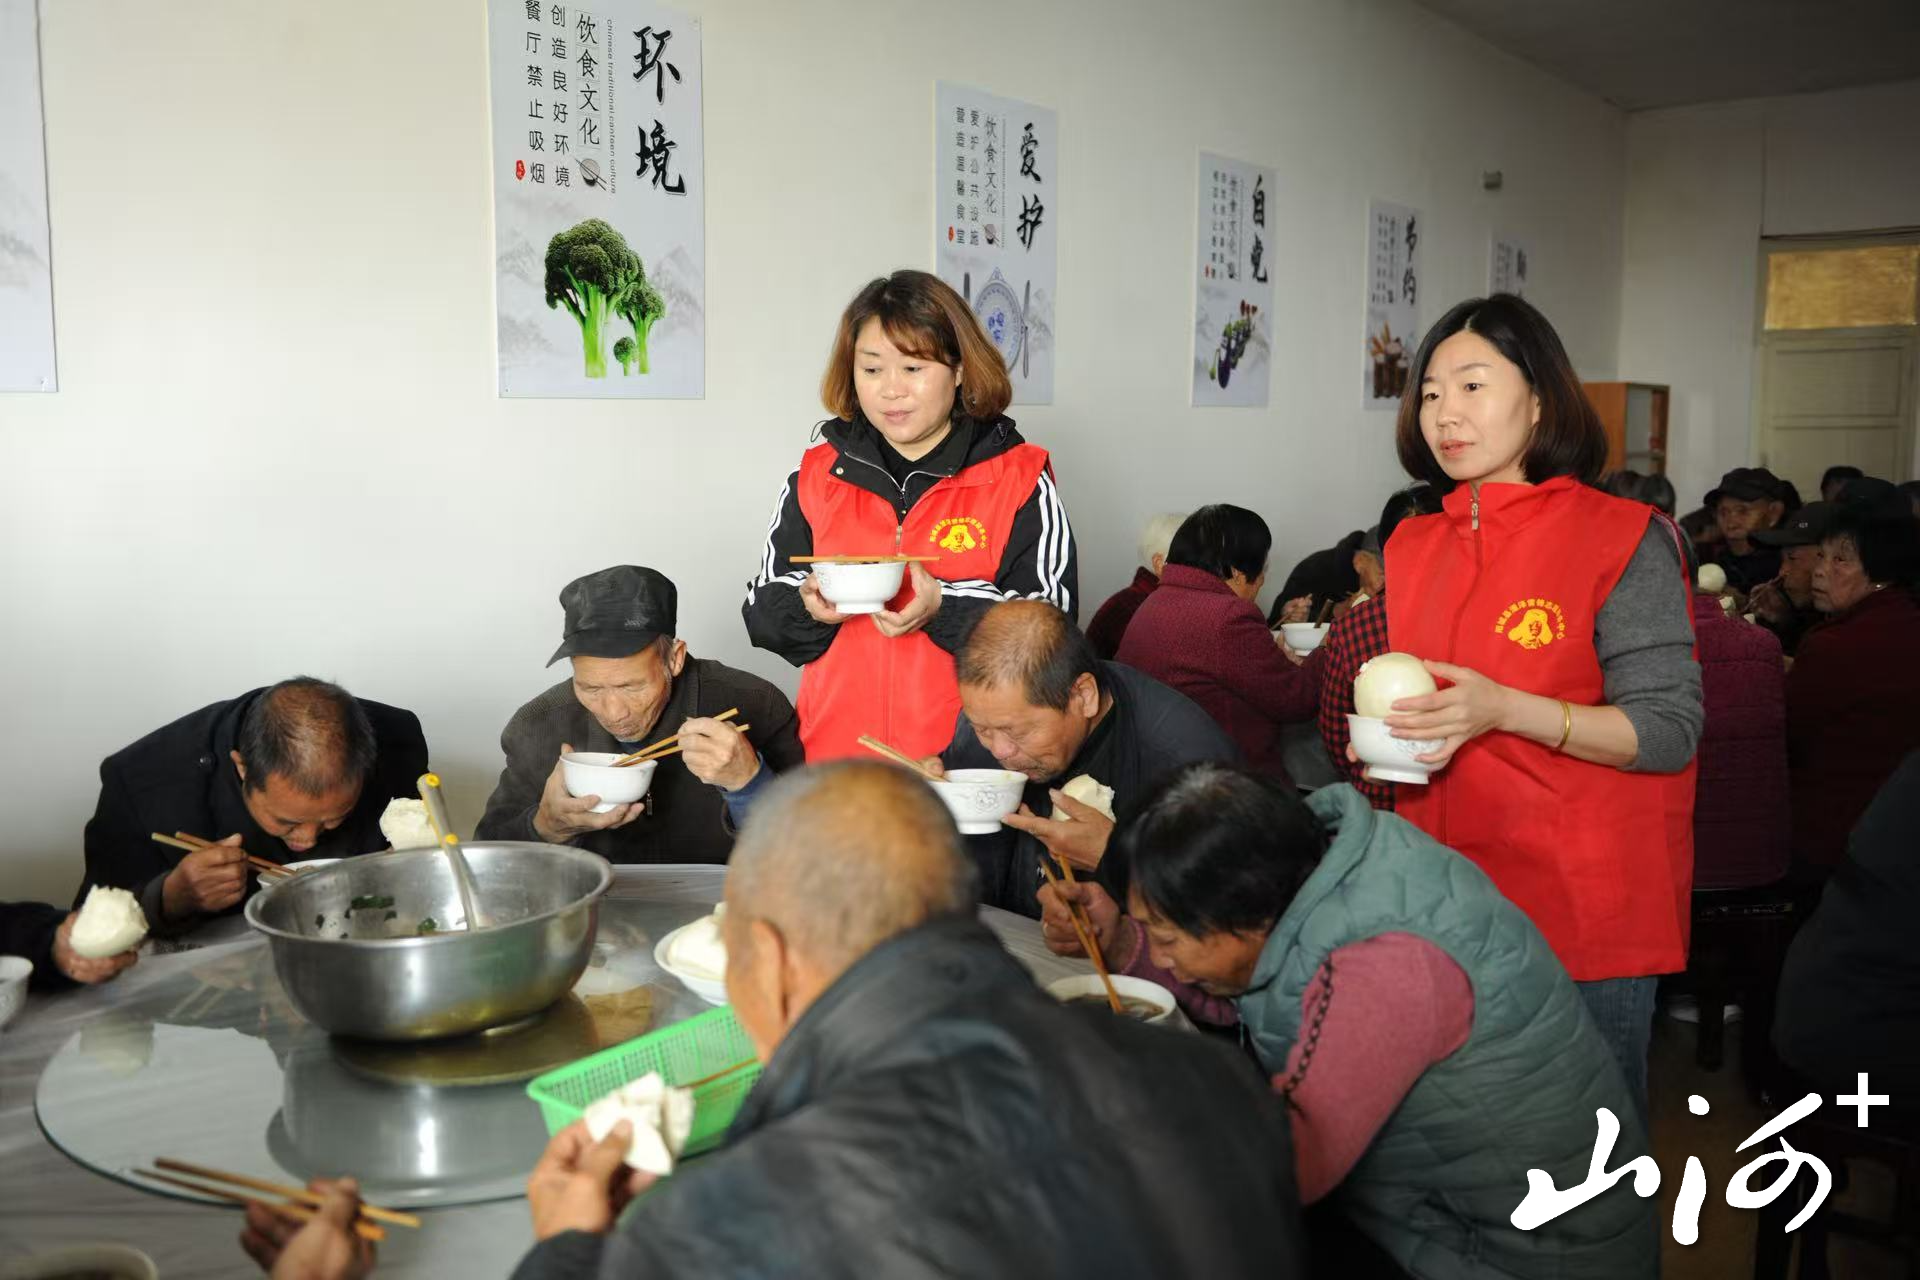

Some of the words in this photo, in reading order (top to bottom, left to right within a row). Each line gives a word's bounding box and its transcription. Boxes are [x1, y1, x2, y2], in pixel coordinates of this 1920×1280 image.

[525, 0, 545, 184] 餐厅禁止吸烟
[550, 4, 570, 188] 创造良好环境
[576, 14, 600, 146] 饮食文化
[633, 26, 686, 195] 环境
[984, 115, 998, 214] 饮食文化
[1016, 122, 1044, 252] 爱护
